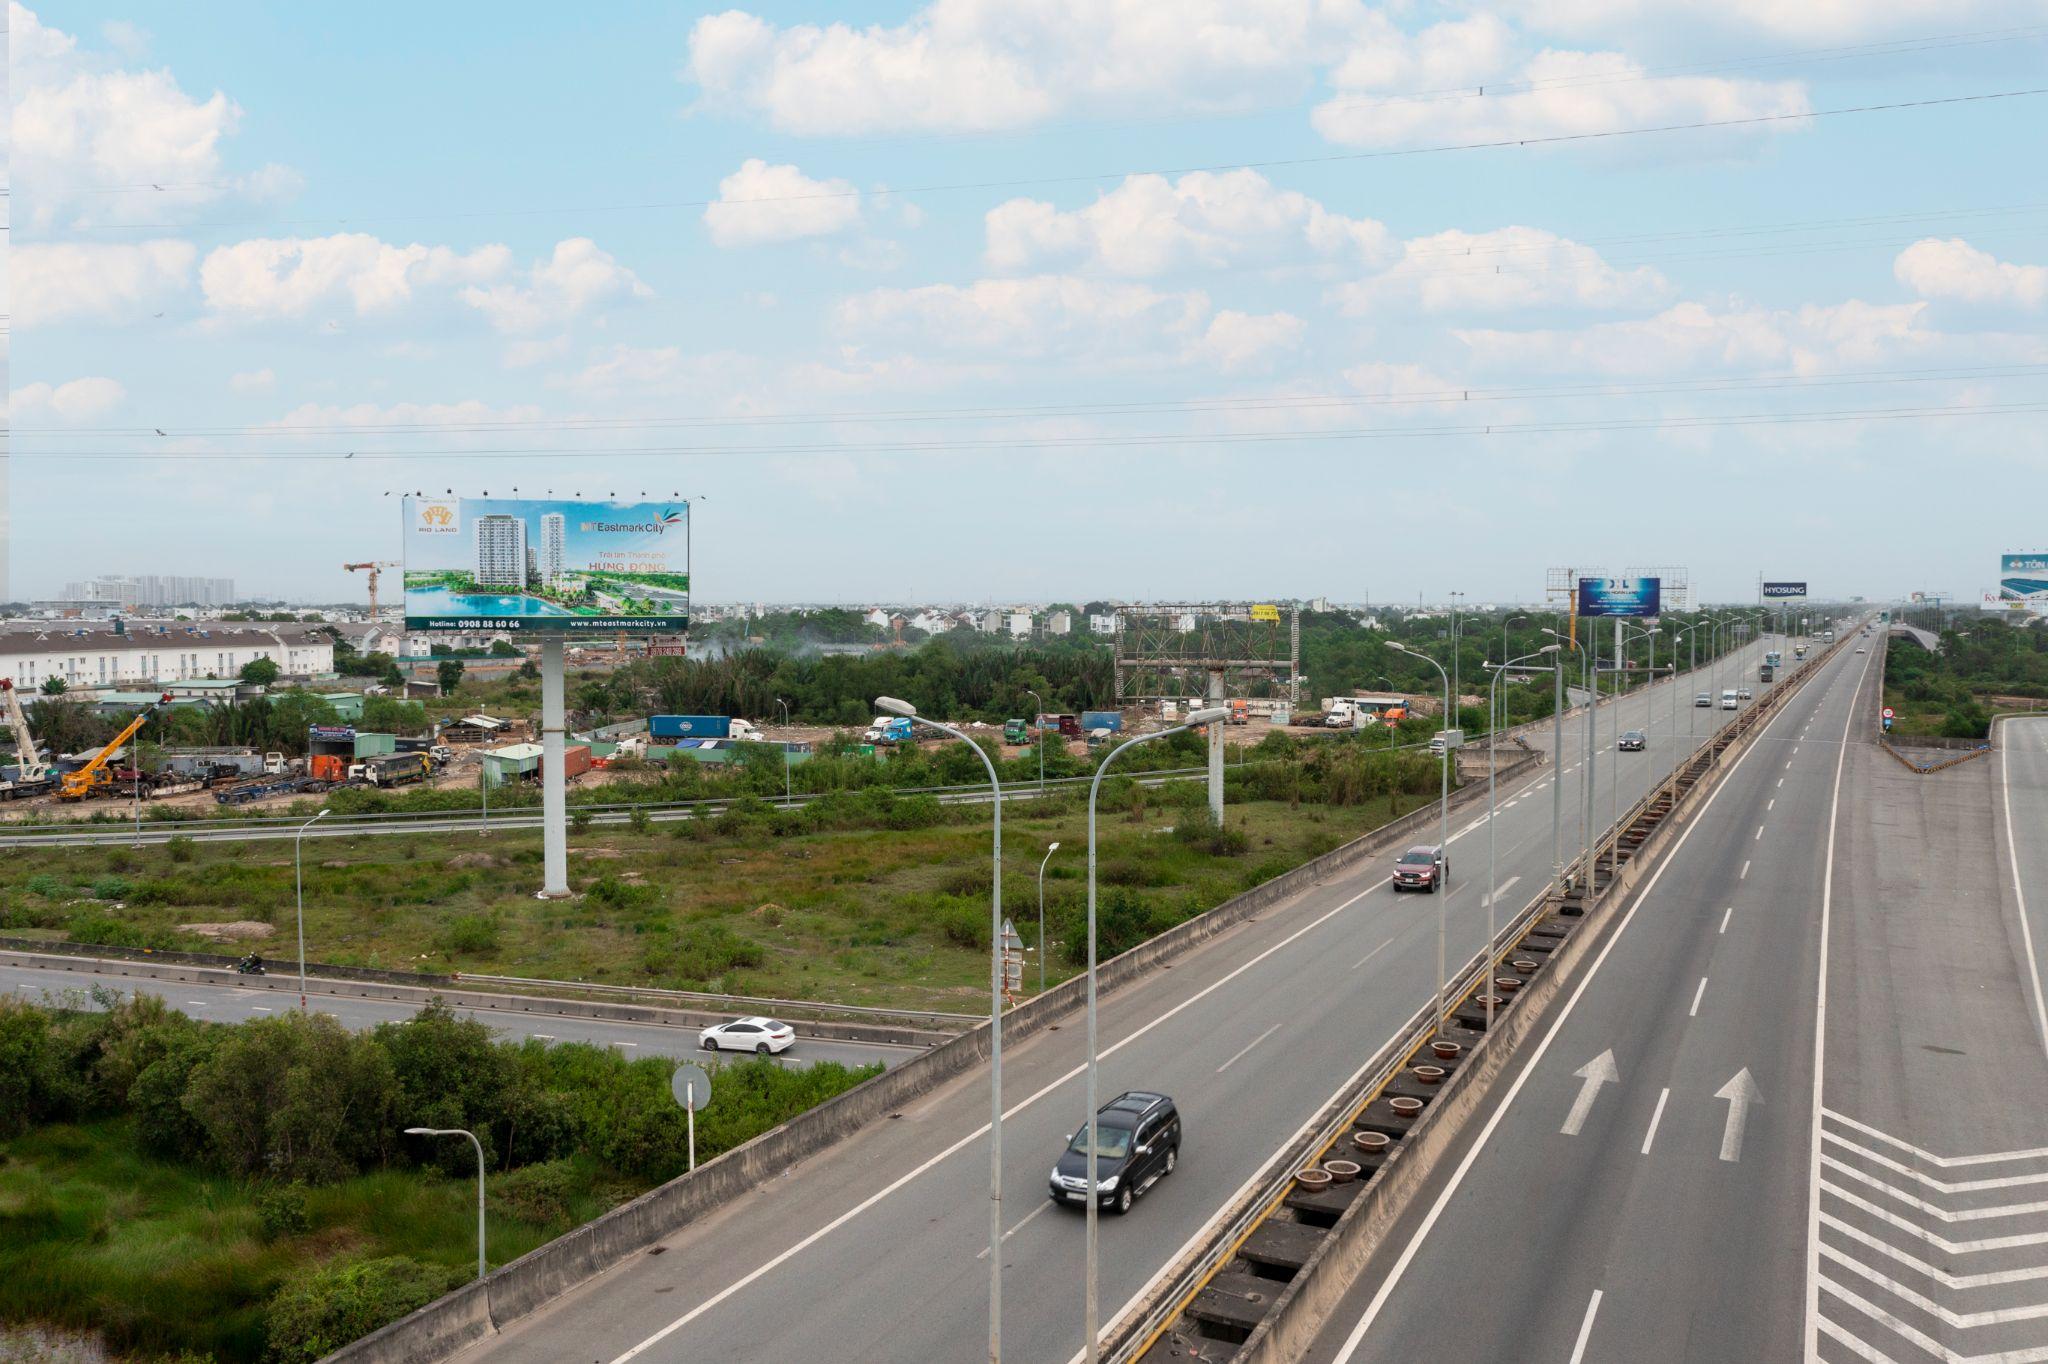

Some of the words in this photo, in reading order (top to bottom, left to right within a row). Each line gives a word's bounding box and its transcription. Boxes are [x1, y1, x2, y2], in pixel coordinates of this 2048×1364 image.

[1764, 586, 1805, 594] HYOSUNG
[458, 620, 480, 628] 0908
[482, 620, 493, 628] 88
[495, 620, 507, 628] 60
[508, 620, 520, 628] 66
[570, 620, 667, 628] www.mteastmarkcity.vn
